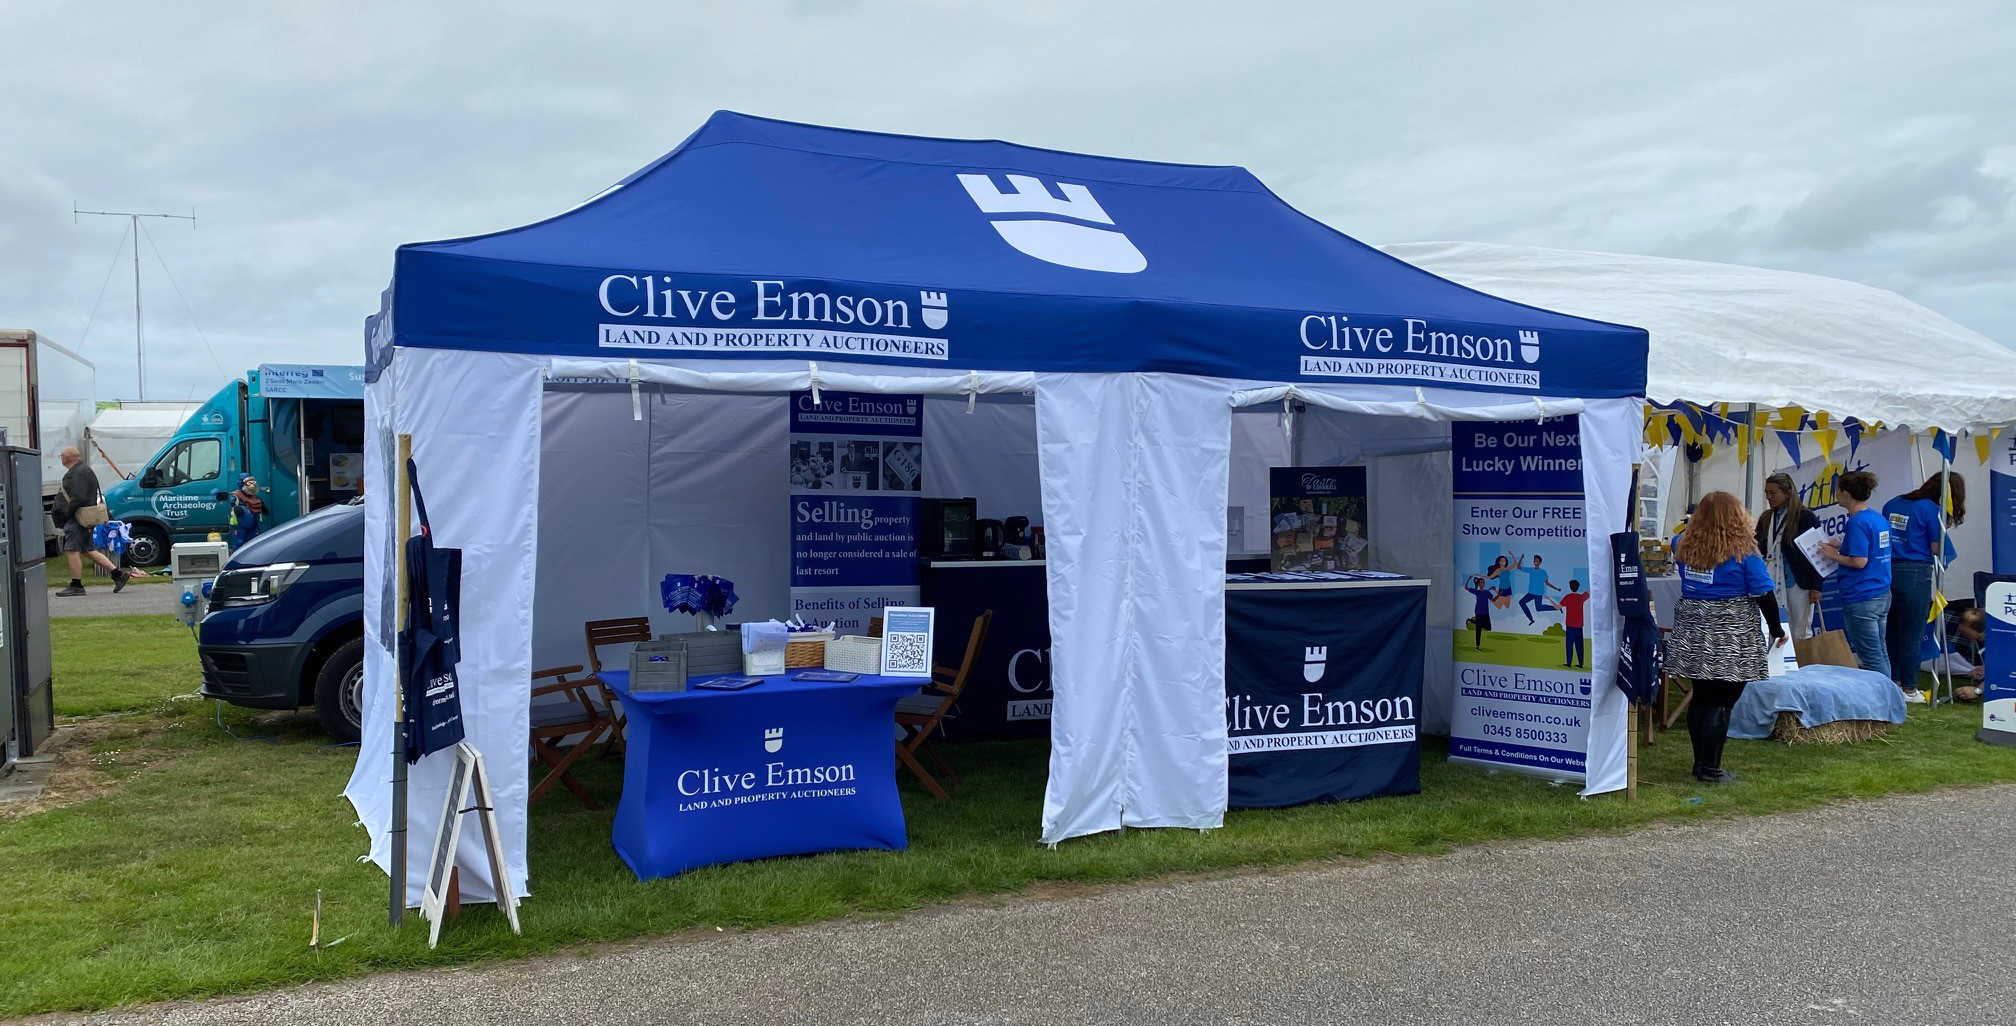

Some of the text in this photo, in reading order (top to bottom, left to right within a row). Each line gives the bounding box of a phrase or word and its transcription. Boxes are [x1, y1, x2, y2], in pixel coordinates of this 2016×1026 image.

[598, 274, 911, 329] Clive Emson
[604, 328, 945, 356] LAND AND PROPERTY AUCTIONEERS
[1300, 314, 1514, 363] Clive Emson
[1303, 359, 1538, 386] LAND AND PROPERTY AUCTIONEERS
[848, 397, 903, 415] Emson
[835, 415, 870, 423] PROPERTY
[871, 417, 915, 425] AUCTIONEERS
[1474, 433, 1498, 448] Be
[1503, 432, 1537, 448] Our
[1462, 456, 1515, 475] Lucky
[159, 494, 199, 502] Maritime
[162, 501, 217, 511] Archaeology
[796, 500, 911, 530] Selling property
[1470, 506, 1582, 519] Enter Our FREE
[796, 532, 914, 543] and land by public auction is
[1462, 523, 1501, 536] Show
[809, 549, 836, 560] longer
[838, 549, 883, 558] considered
[891, 549, 908, 558] sale
[909, 549, 917, 558] of
[796, 566, 839, 575] last resort
[794, 597, 845, 611] Benefits
[848, 597, 862, 610] of
[1461, 668, 1576, 695] Clive Emson
[1462, 688, 1591, 708] LAND AND PROPERTY AUCTIONEERS
[1300, 692, 1415, 727] Emson
[1470, 705, 1581, 728] cliveemson.co.uk
[1228, 728, 1414, 751] ND AND PROPERTY AUCTIONEERS
[1483, 724, 1568, 744] 0345 8500333
[1459, 744, 1472, 752] Full
[1473, 746, 1493, 755] Terms
[1501, 750, 1538, 761] Conditions
[1538, 754, 1549, 762] On
[1550, 756, 1564, 764] Our
[1565, 757, 1585, 767] Webs
[677, 761, 855, 796] Clive Emson
[678, 786, 856, 812] LAND AND PROPERTY AUCTIONEERS
